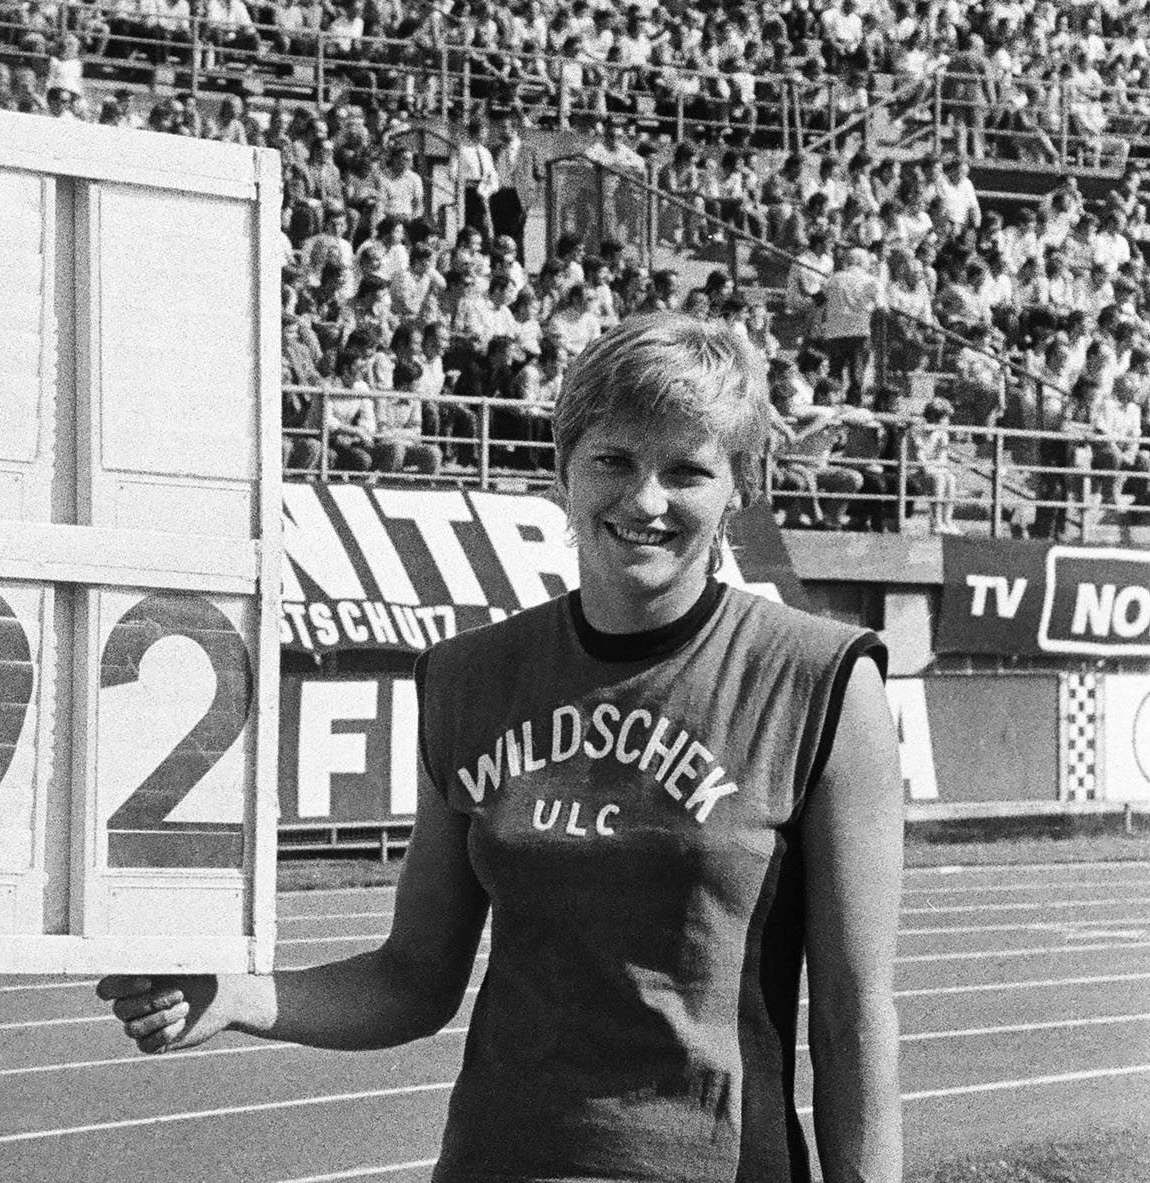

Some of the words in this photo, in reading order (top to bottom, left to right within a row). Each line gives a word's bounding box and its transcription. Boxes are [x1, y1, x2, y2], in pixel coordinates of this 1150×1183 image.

[966, 574, 1028, 619] TV
[457, 703, 739, 824] WILDSCHEK
[532, 799, 620, 836] ULC
